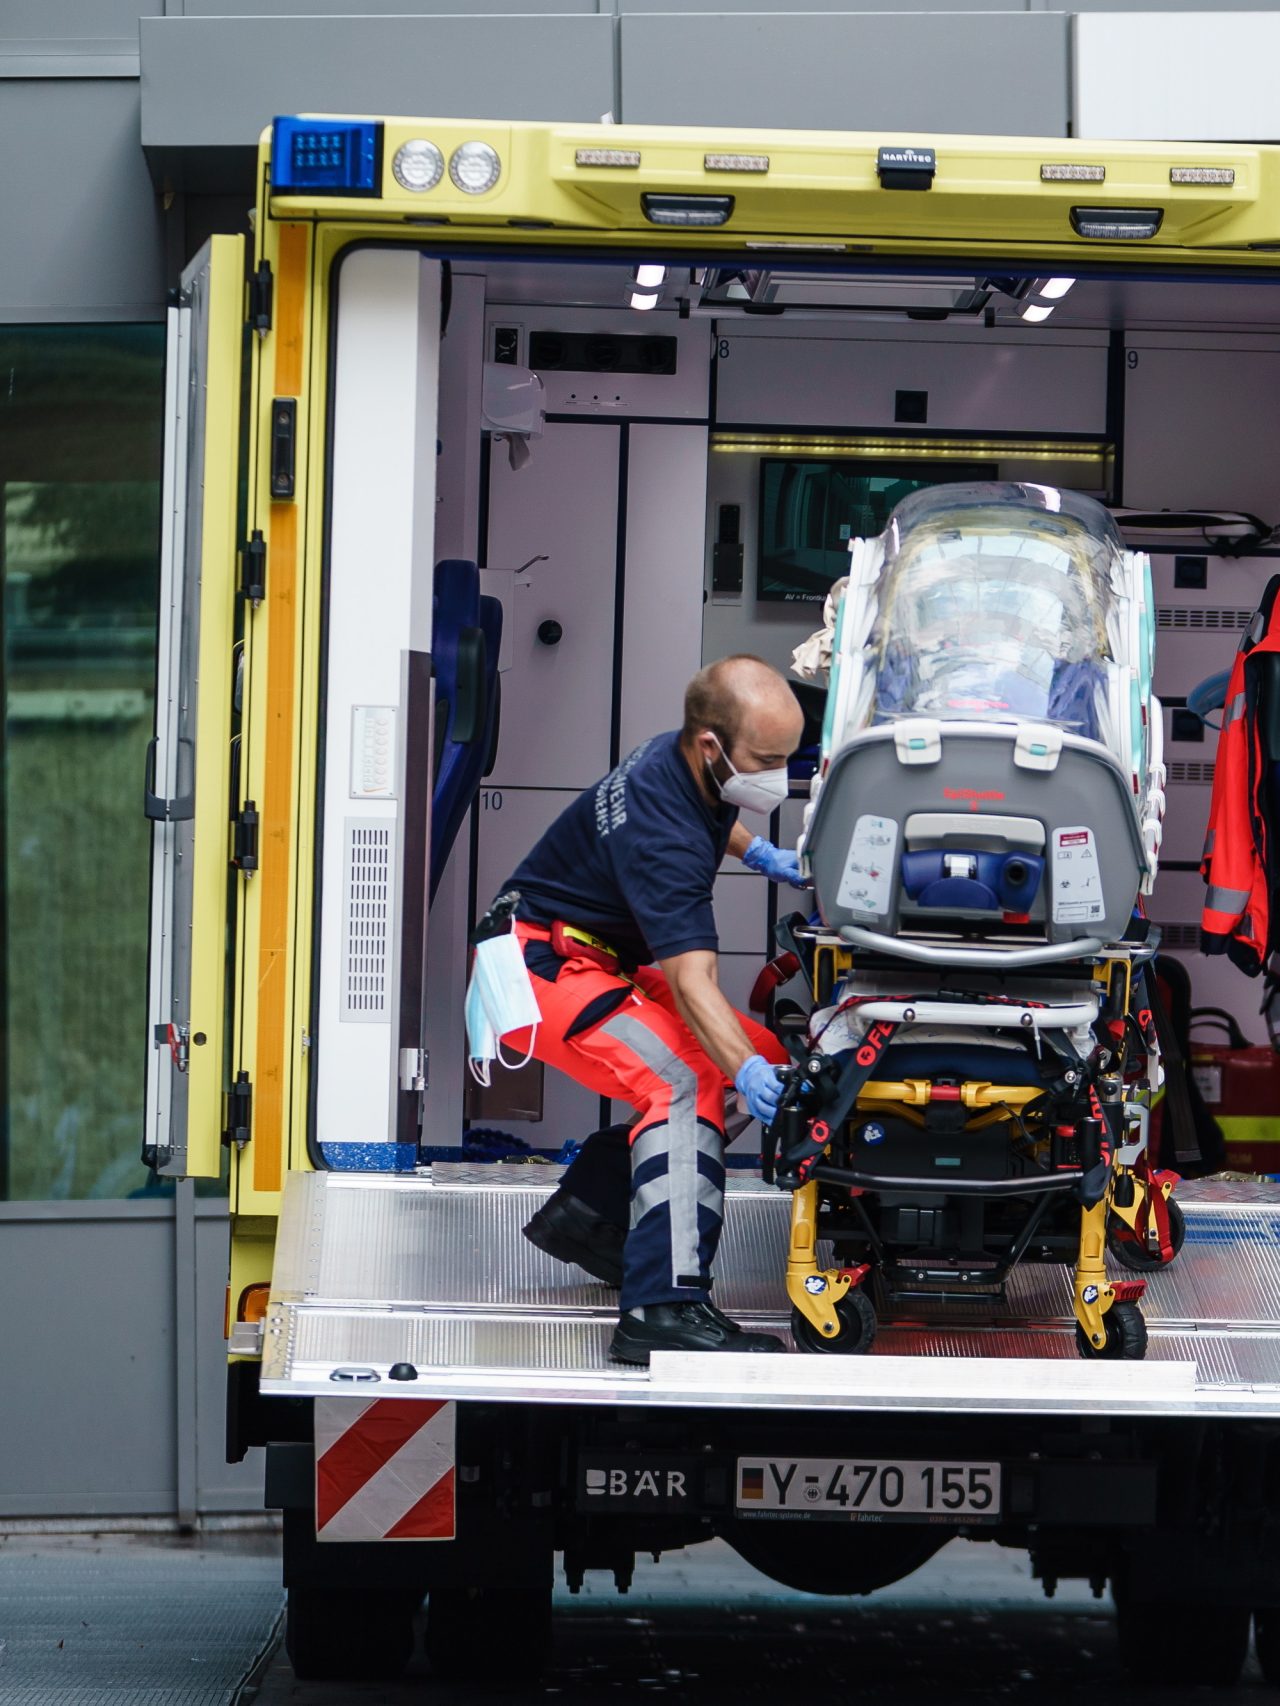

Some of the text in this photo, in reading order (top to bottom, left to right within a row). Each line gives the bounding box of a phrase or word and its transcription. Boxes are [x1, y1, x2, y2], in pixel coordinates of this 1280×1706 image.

[719, 339, 730, 359] 8
[1127, 350, 1139, 370] 9
[481, 790, 503, 810] 10
[609, 1469, 688, 1497] BÄR
[921, 1467, 993, 1510] 155
